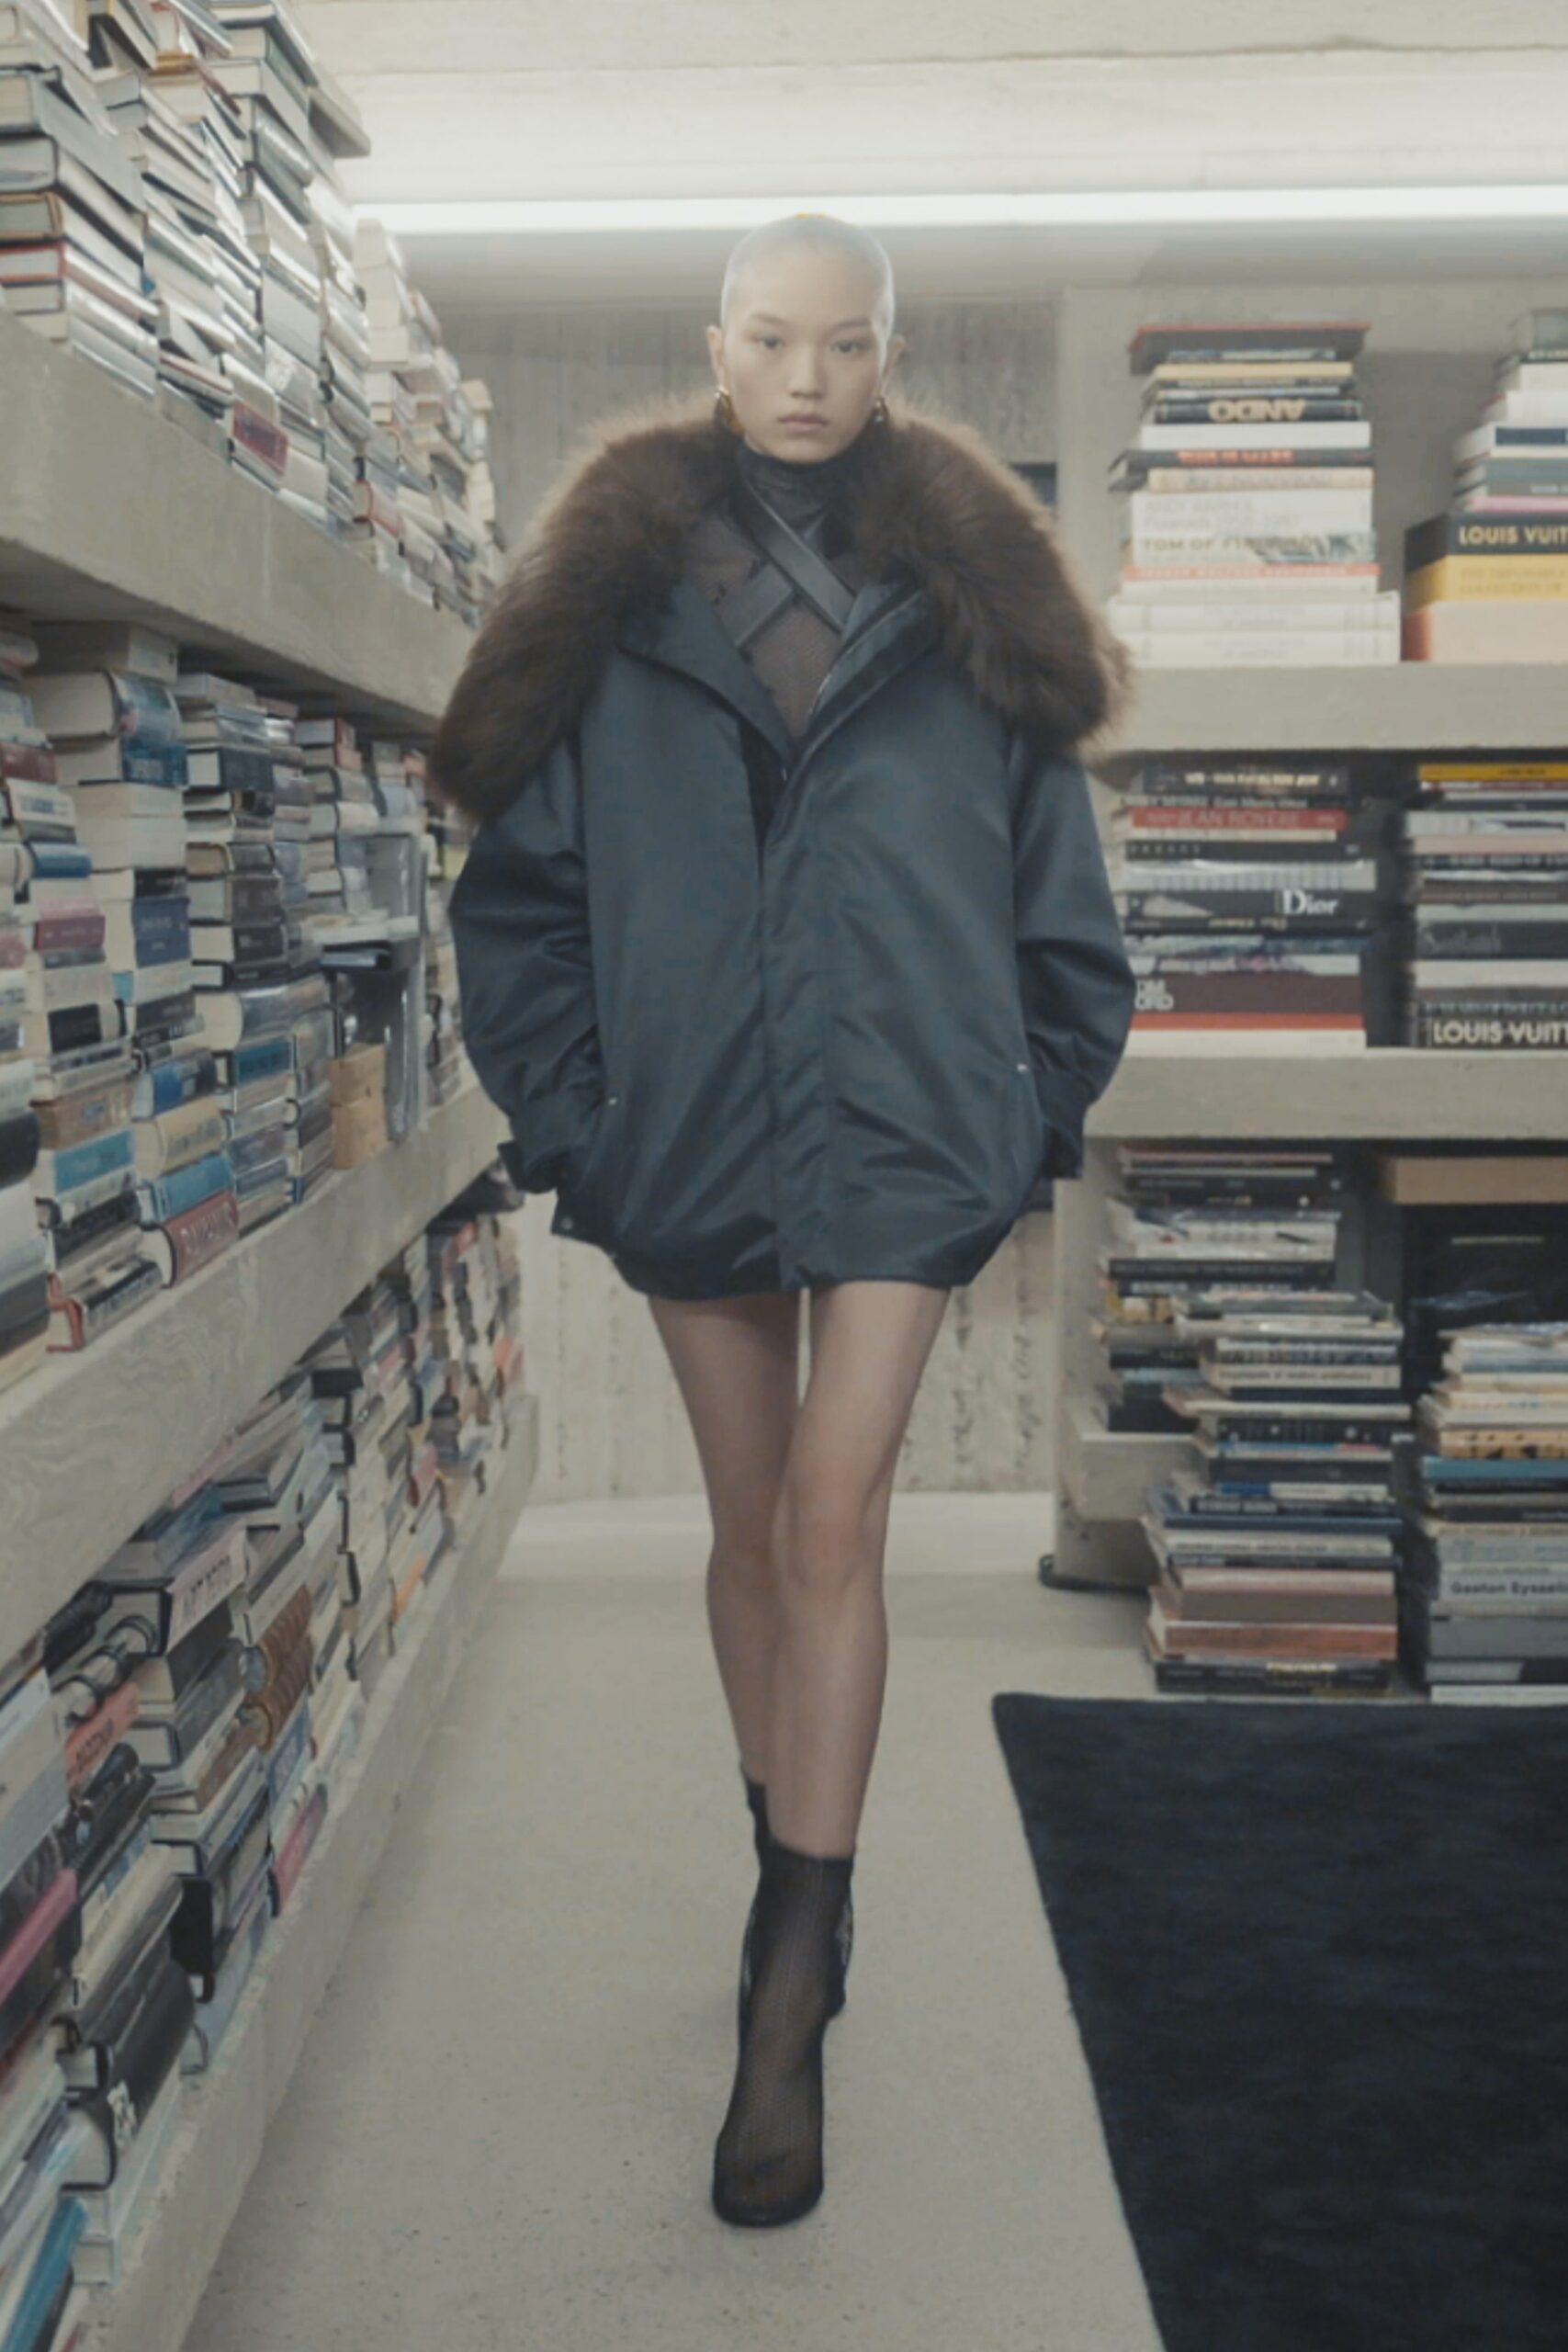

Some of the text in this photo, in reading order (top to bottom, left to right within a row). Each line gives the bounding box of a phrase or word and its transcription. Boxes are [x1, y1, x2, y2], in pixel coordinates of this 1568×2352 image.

[1208, 399, 1306, 422] ANDO
[1458, 525, 1517, 547] LOUIS
[1281, 888, 1340, 916] Dior
[1432, 1021, 1504, 1044] LOUIS
[1451, 1581, 1506, 1594] Gaston
